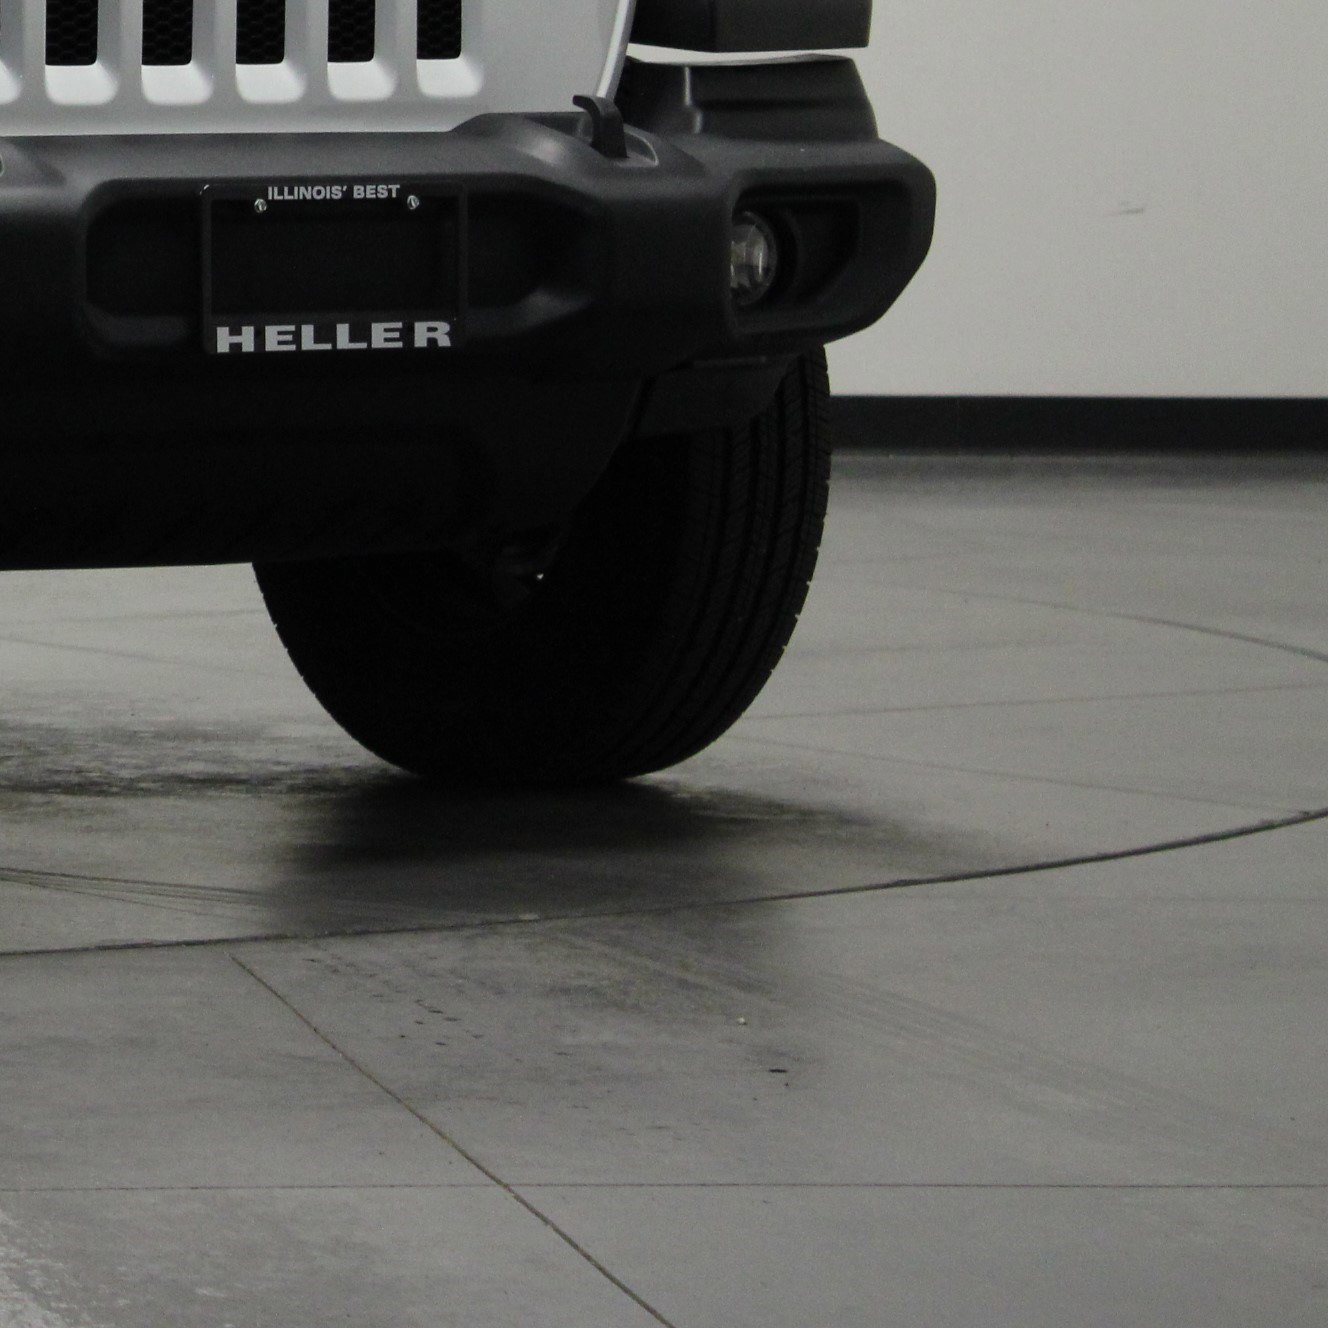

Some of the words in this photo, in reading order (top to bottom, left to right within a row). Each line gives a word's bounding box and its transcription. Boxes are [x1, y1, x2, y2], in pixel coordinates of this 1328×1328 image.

[267, 185, 348, 201] ILLINOIS'
[352, 184, 401, 199] BEST
[216, 321, 452, 354] HELLER
